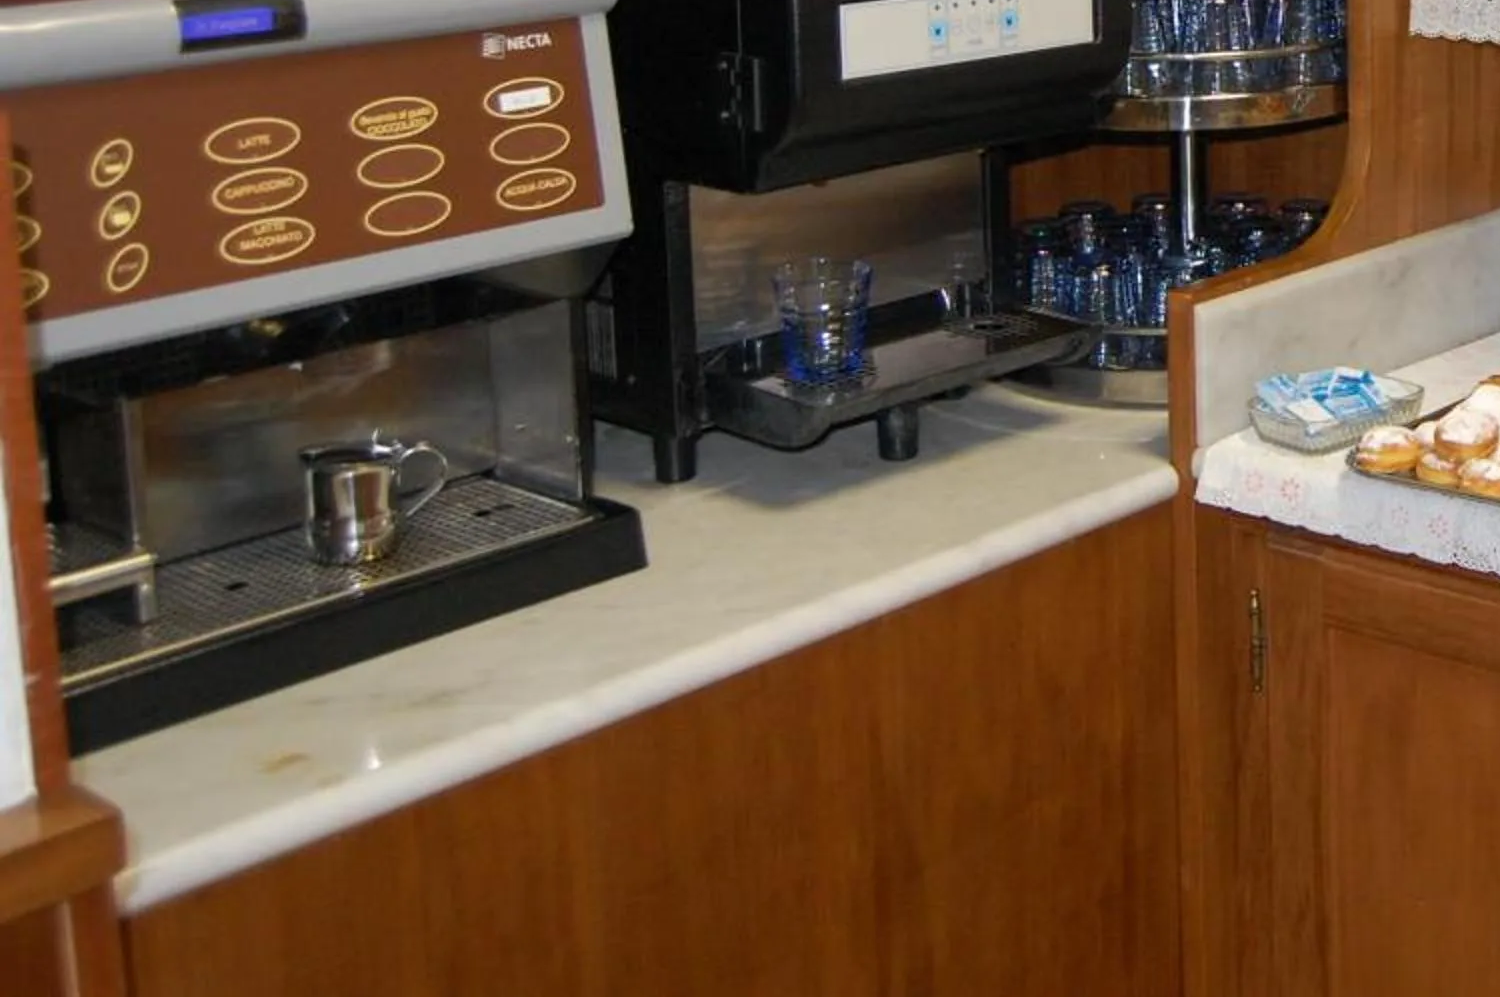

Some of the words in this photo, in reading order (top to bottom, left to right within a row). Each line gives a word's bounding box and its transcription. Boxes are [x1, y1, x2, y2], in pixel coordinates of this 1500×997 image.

[507, 31, 553, 52] NECTA
[238, 134, 272, 150] LATTE
[224, 175, 296, 200] CAPPUCCINO
[253, 220, 286, 236] LATTE
[239, 231, 303, 251] MACCHIATO
